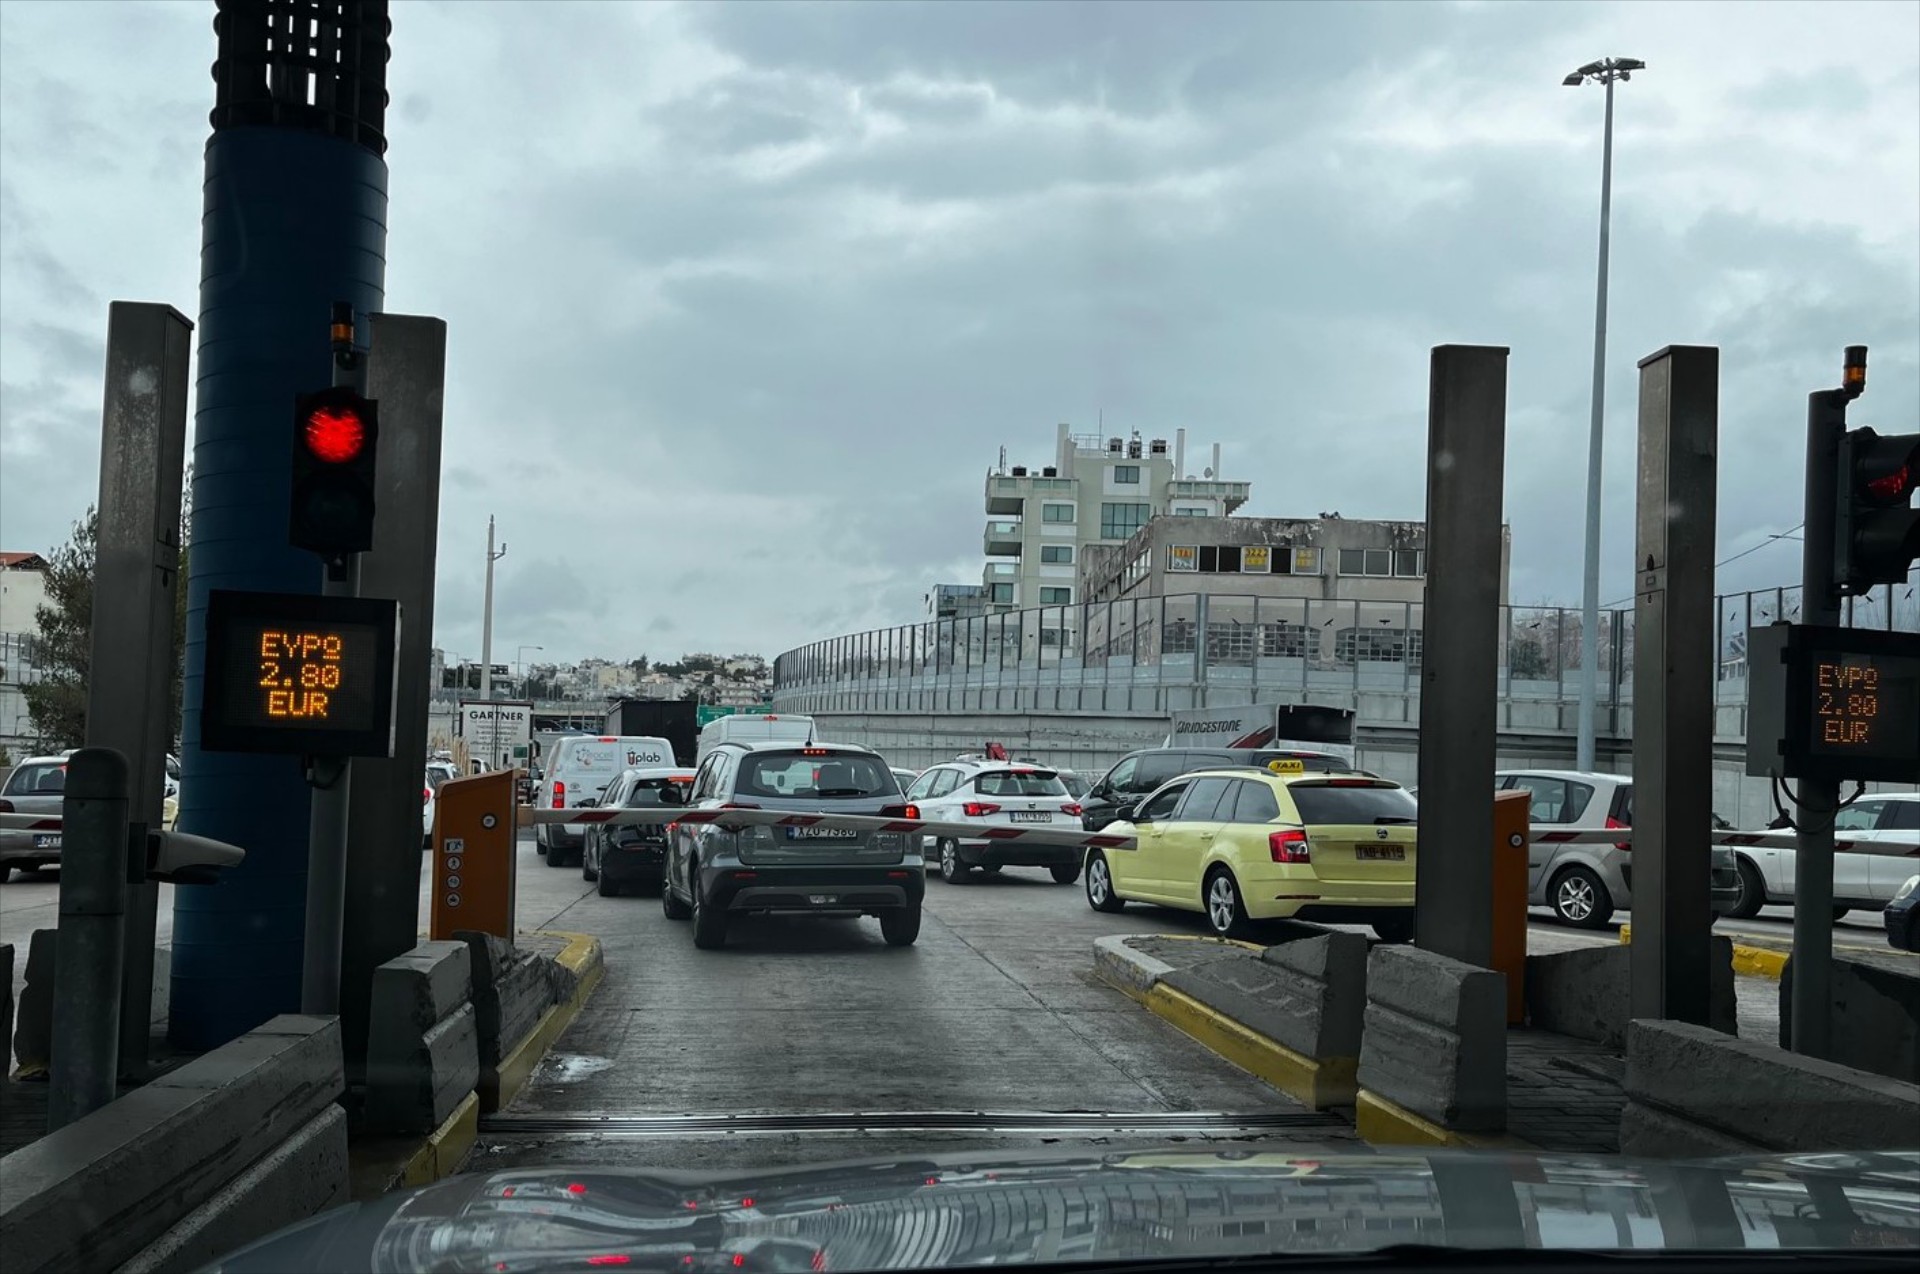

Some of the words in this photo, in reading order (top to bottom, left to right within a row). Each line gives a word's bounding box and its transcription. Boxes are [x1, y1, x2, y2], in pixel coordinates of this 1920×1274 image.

[262, 633, 341, 659] ΕΥΡΩ
[260, 663, 340, 688] 2.80
[269, 690, 328, 716] EUR
[1819, 692, 1877, 717] 2.80
[469, 711, 524, 721] GARTNER
[1176, 720, 1242, 734] BRIDGESTONE
[1825, 720, 1868, 743] EUR
[1276, 761, 1301, 769] TAXI
